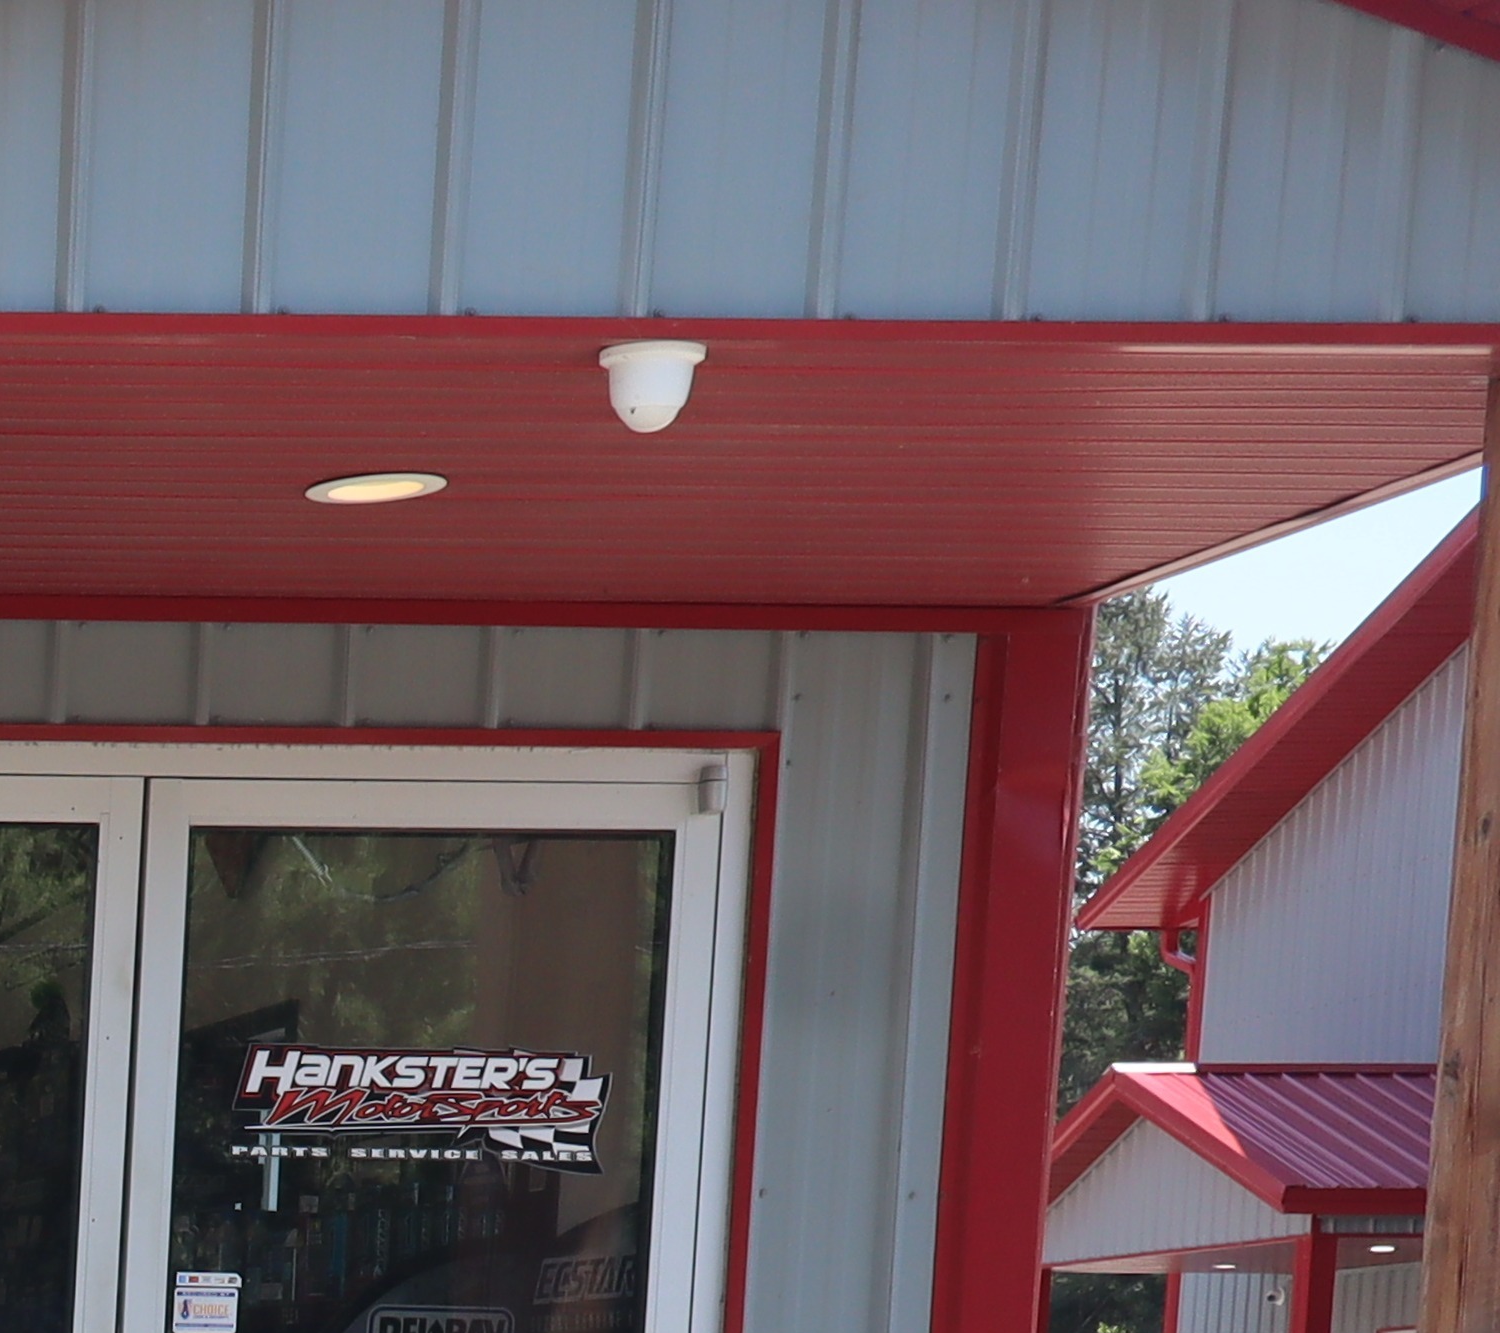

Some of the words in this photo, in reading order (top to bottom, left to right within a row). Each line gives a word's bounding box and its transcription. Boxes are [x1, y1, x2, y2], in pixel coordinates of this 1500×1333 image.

[232, 1145, 329, 1158] PARTS
[351, 1147, 481, 1160] SERVICE
[502, 1150, 592, 1162] SALES
[193, 1304, 230, 1315] CHOICE
